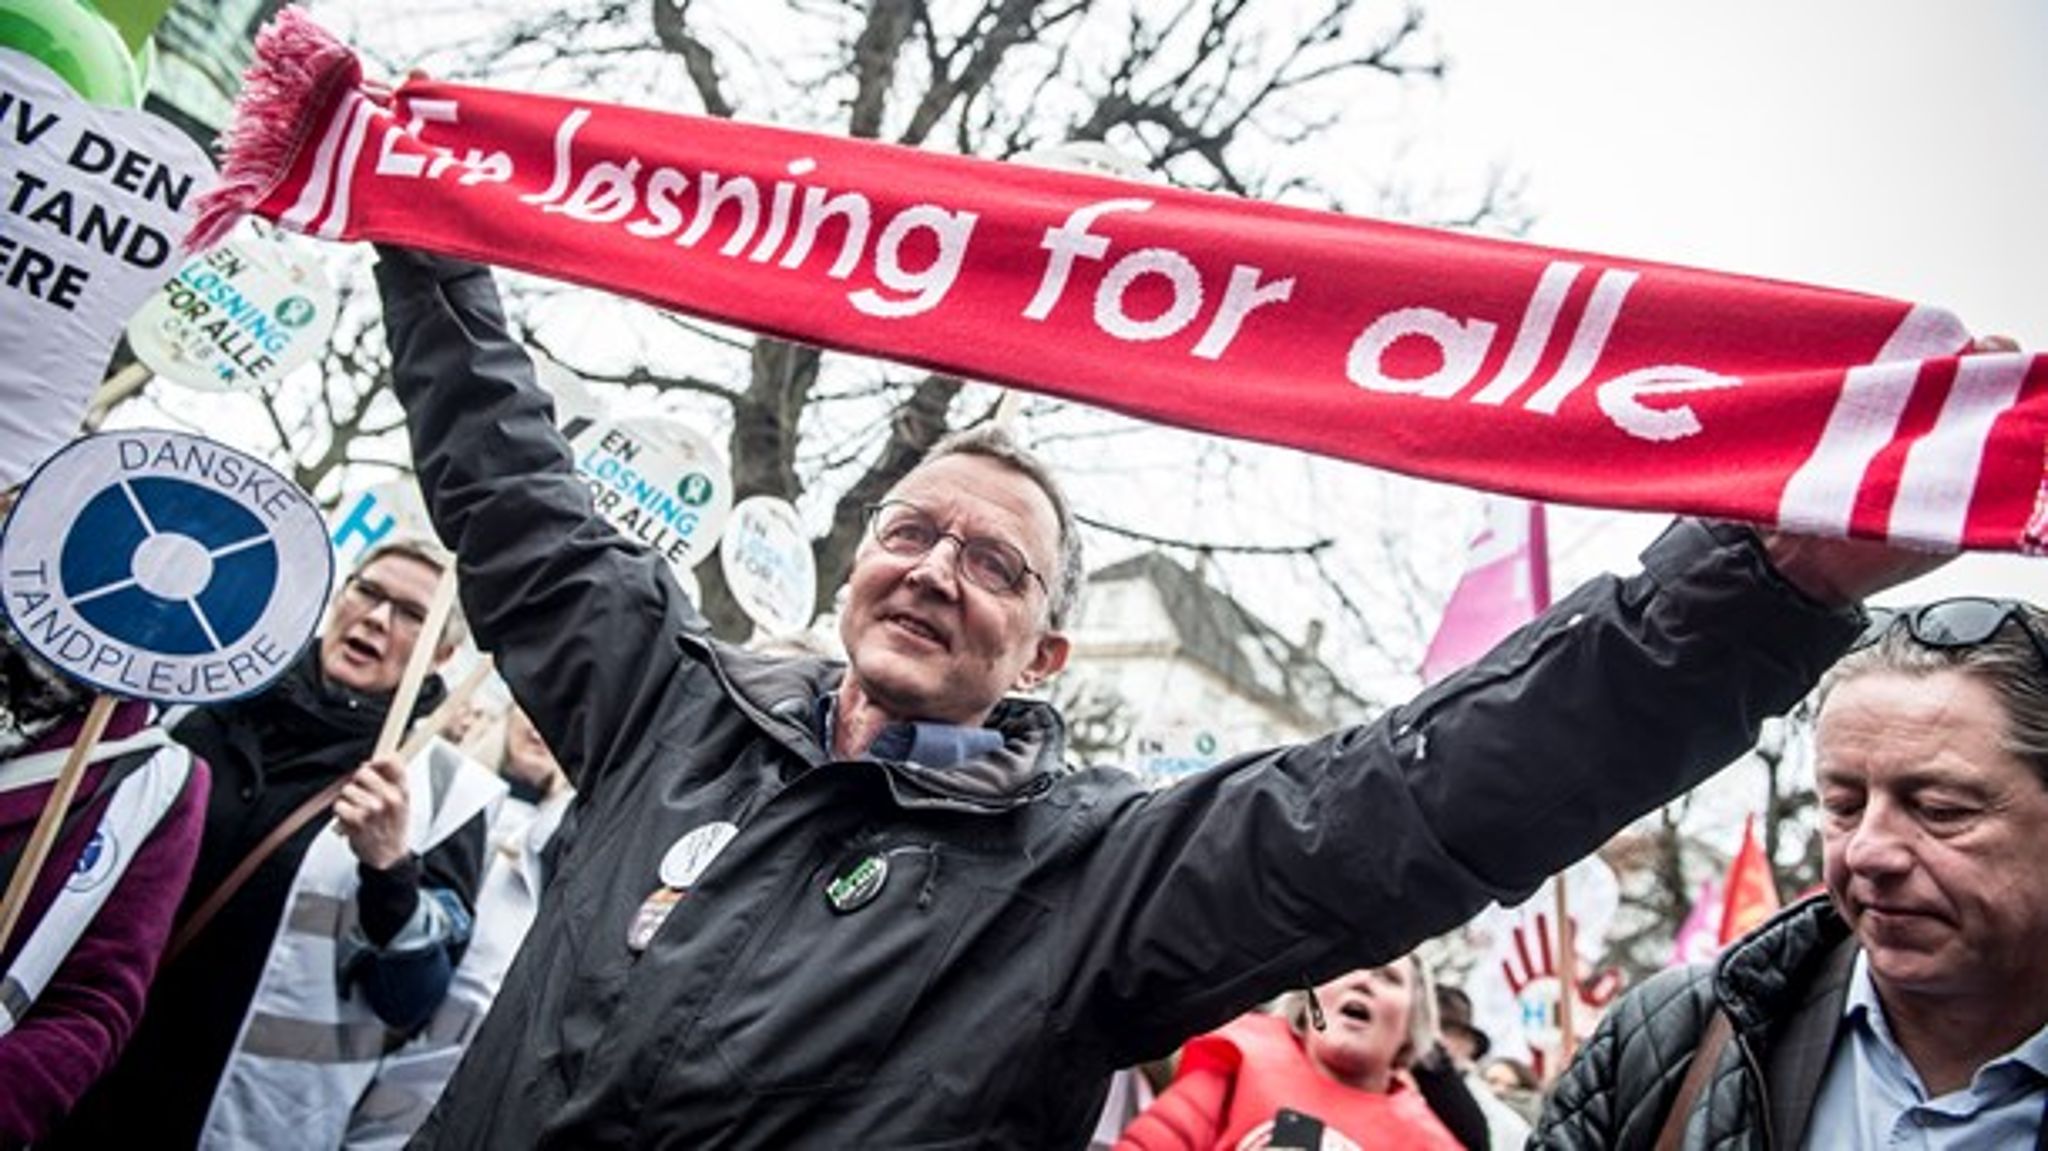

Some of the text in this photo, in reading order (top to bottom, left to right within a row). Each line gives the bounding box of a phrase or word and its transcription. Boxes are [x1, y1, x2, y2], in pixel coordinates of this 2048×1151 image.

[67, 130, 194, 213] DEN
[9, 170, 170, 270] TAND
[205, 247, 248, 278] EN
[518, 107, 979, 318] løsning
[1021, 198, 1297, 361] for
[1345, 260, 1744, 442] alle
[163, 277, 211, 323] FOR
[201, 318, 276, 379] ALLE
[119, 439, 298, 521] DANSKE
[600, 429, 642, 463] EN
[617, 506, 692, 565] ALLE
[10, 559, 287, 697] TANDPLEJERE
